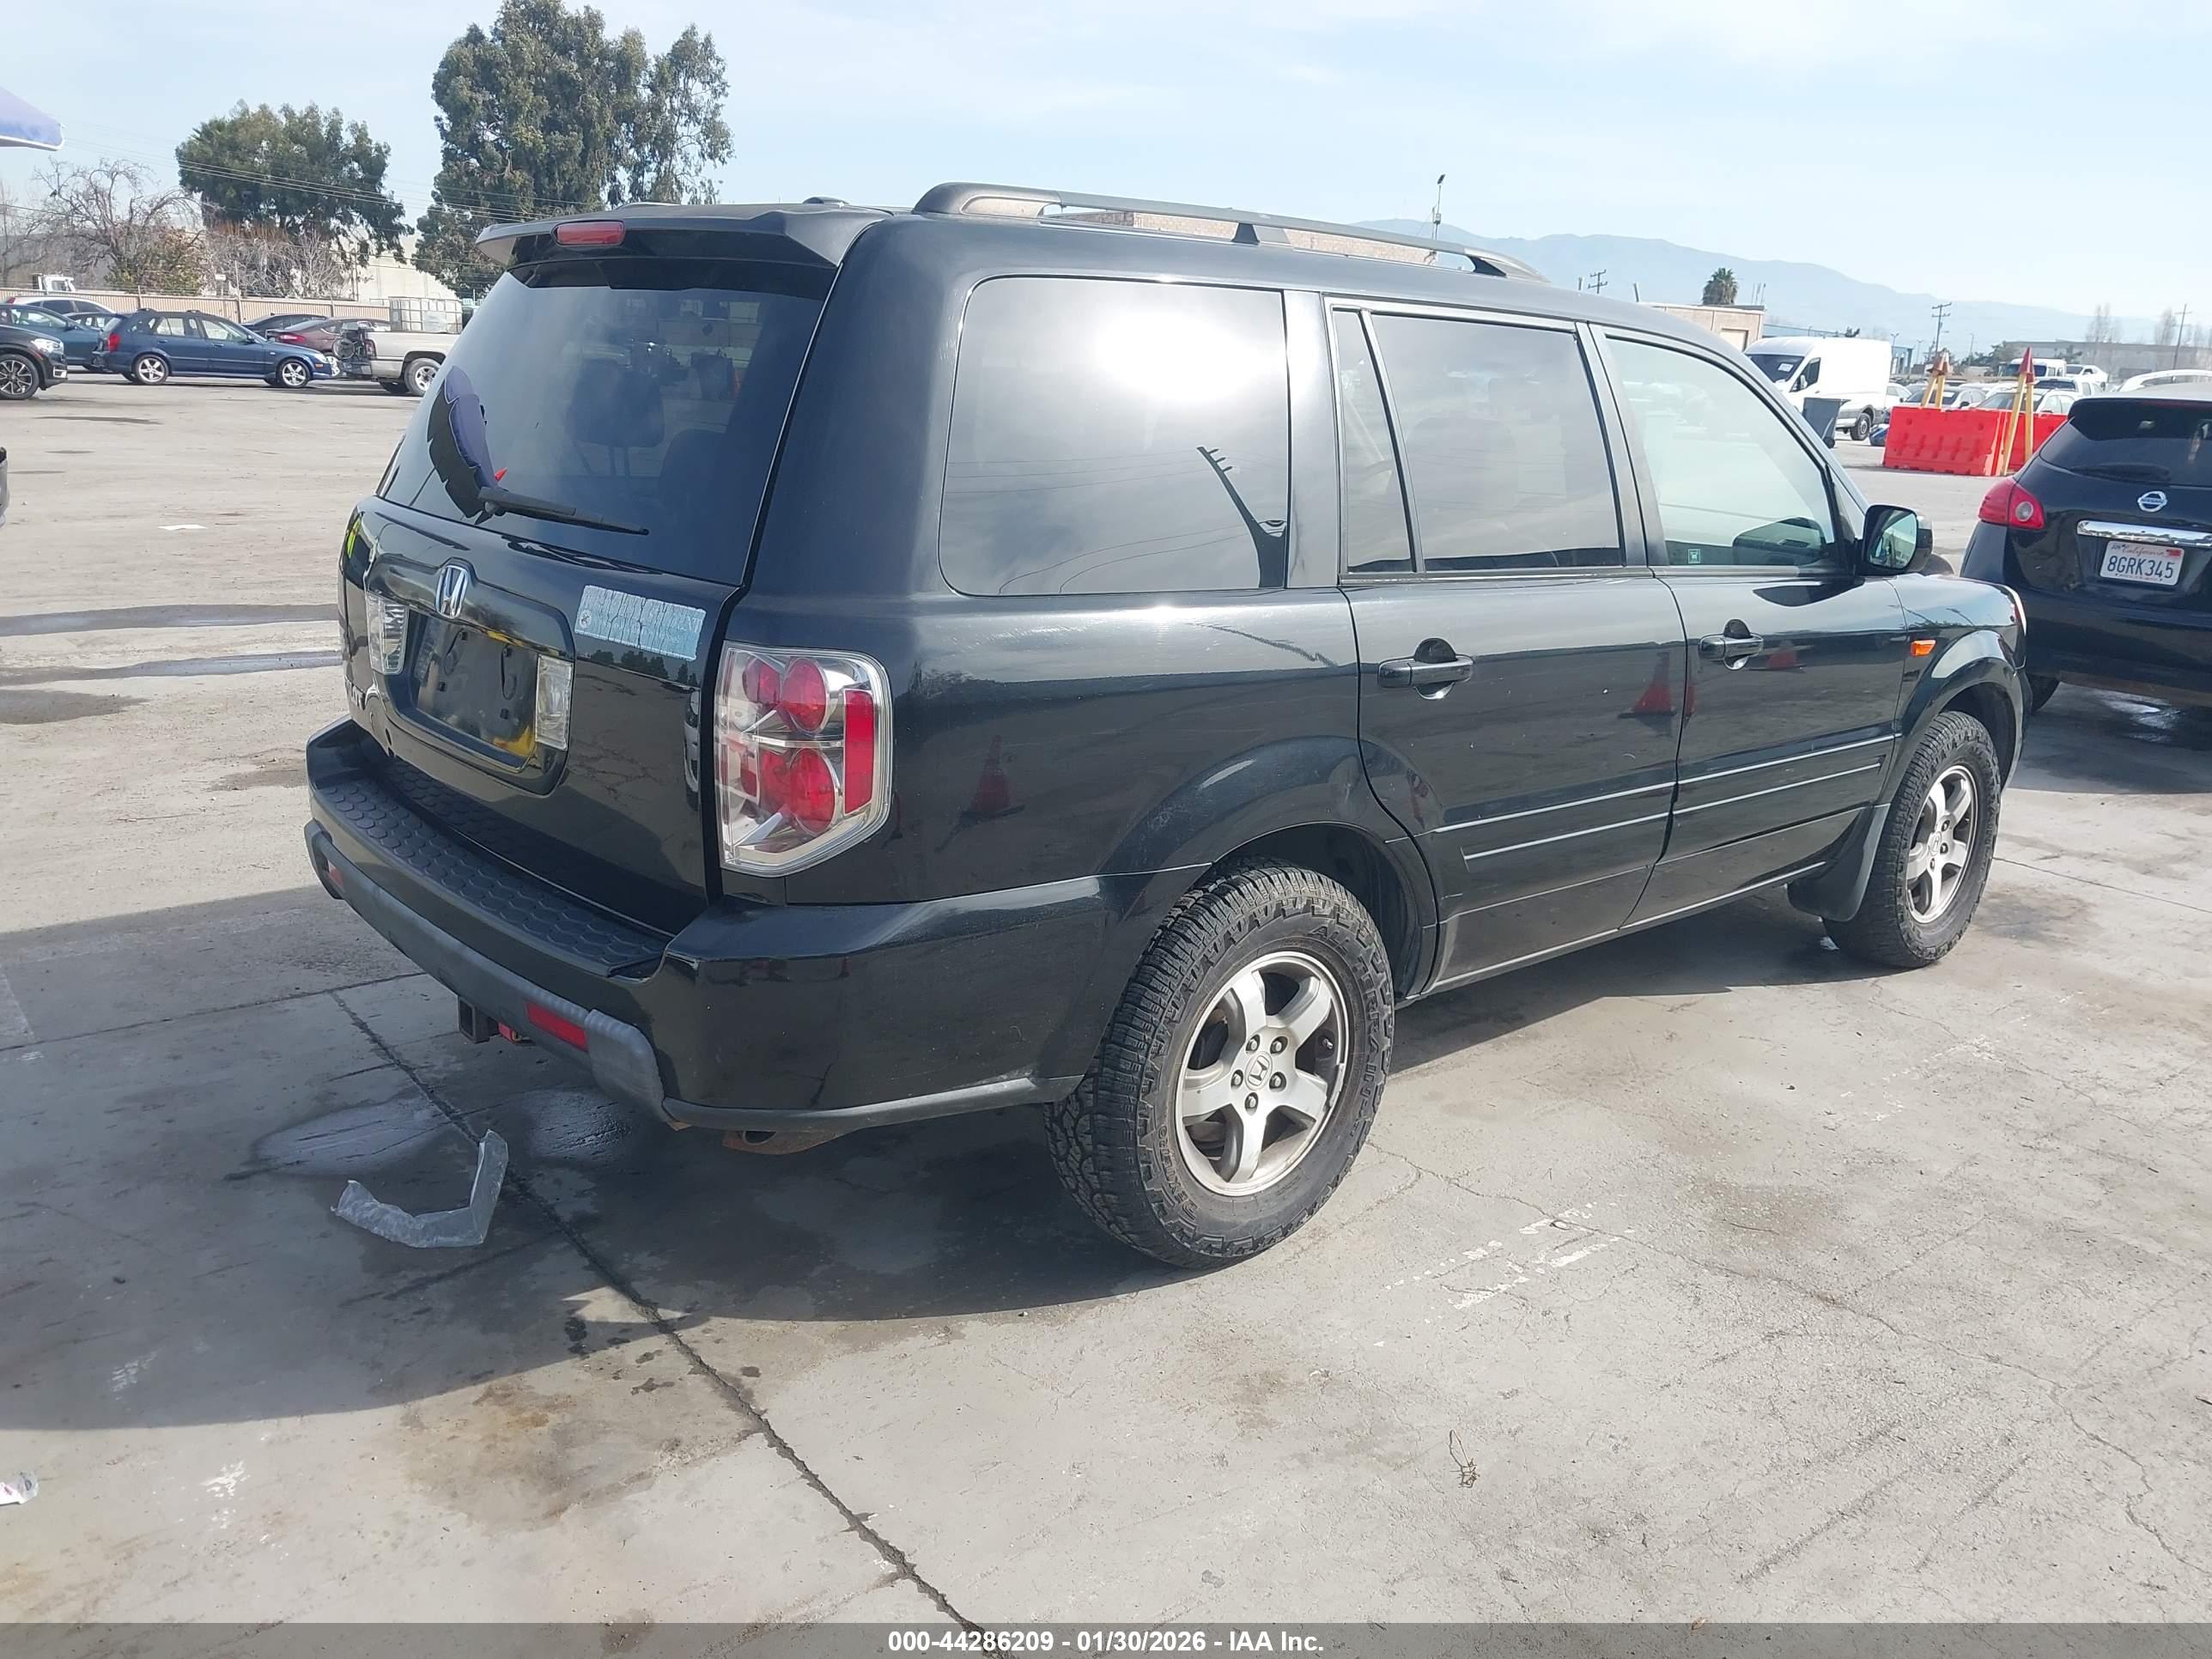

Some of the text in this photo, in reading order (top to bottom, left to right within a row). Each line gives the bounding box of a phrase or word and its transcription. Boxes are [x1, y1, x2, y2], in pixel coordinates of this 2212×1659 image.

[2106, 555, 2175, 579] 8GRK345
[1308, 926, 1348, 956] ALL
[1158, 1125, 1199, 1220] DEXTERO
